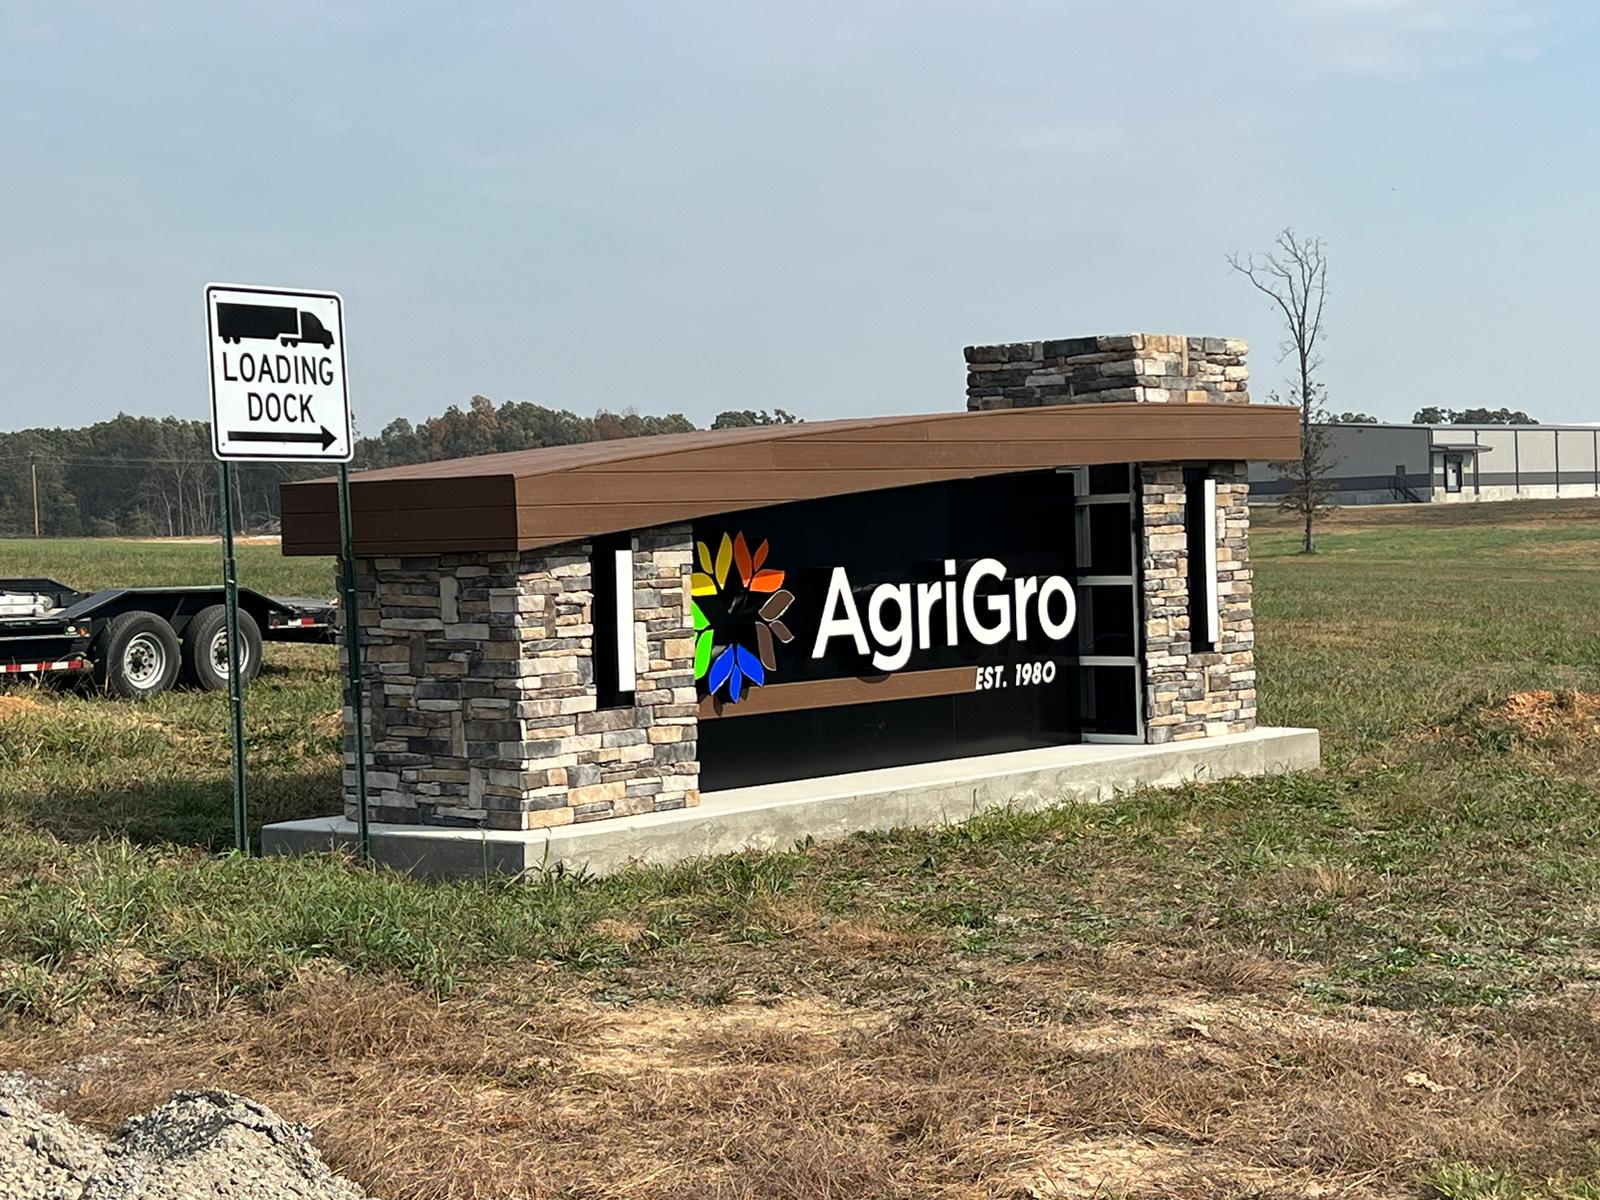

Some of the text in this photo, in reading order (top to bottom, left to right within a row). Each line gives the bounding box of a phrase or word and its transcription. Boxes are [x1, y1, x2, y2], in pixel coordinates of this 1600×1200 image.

[222, 351, 334, 386] LOADING
[247, 392, 316, 423] DOCK
[811, 558, 1076, 671] AgriGro
[975, 660, 1056, 690] EST. 1980
